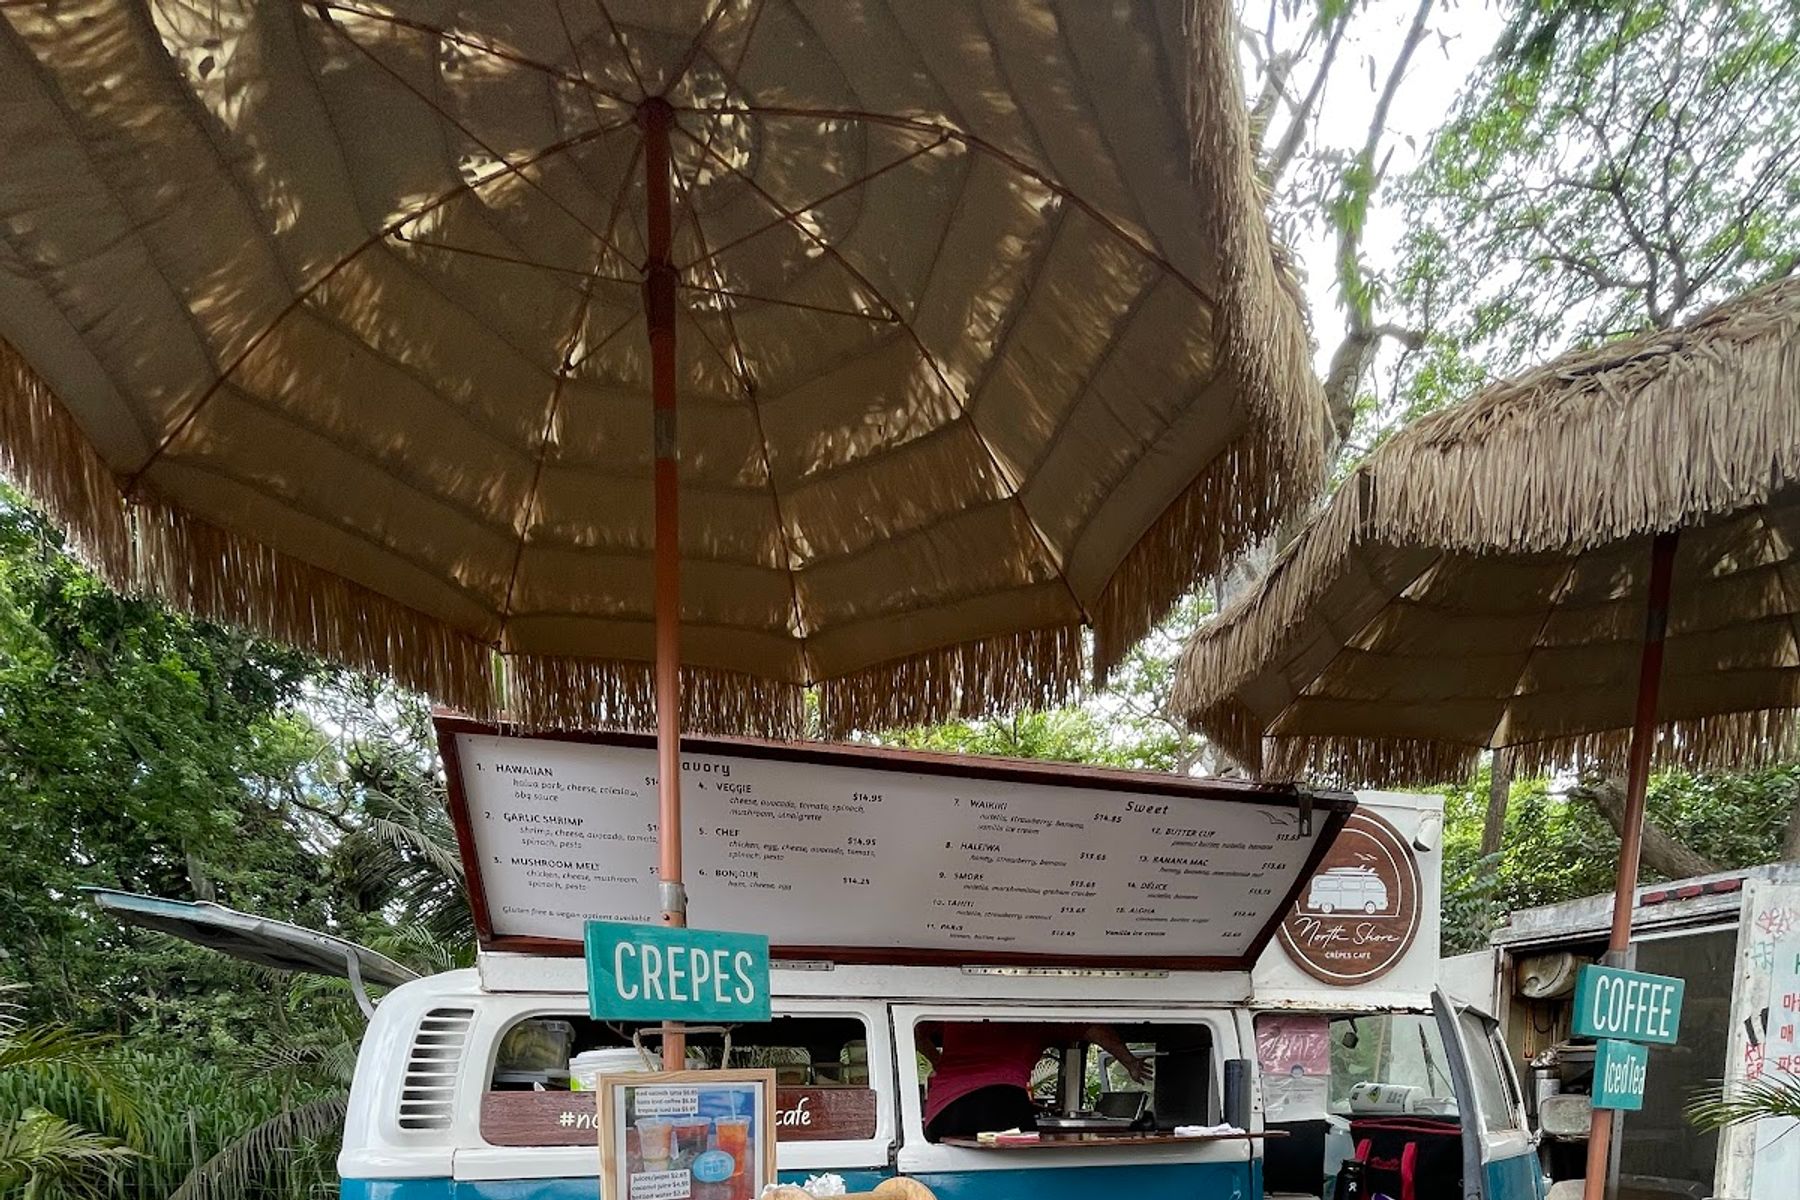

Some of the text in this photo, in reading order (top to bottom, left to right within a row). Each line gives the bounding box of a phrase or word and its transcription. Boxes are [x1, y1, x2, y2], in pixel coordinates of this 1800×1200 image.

[496, 763, 553, 776] HAWAIIAN
[682, 761, 731, 777] avory
[716, 782, 751, 794] VEGGIE
[852, 792, 882, 803] $14.95
[970, 799, 1008, 811] WAIKIKI
[1125, 800, 1169, 815] Sweet
[503, 812, 541, 824] GARLIC
[543, 815, 584, 827] SHRIMP
[715, 828, 740, 837] CHEF
[1165, 827, 1197, 837] BUTTER
[1198, 830, 1217, 838] CUP
[960, 842, 1001, 852] HALEIWA
[511, 857, 573, 870] MUSHROOM
[576, 862, 600, 871] MELT
[715, 869, 759, 879] BONJOUR
[1294, 917, 1400, 948] North Shore
[614, 941, 755, 1005] CREPES
[1592, 975, 1675, 1037] COFFEE
[1604, 1053, 1646, 1095] Iced Tea
